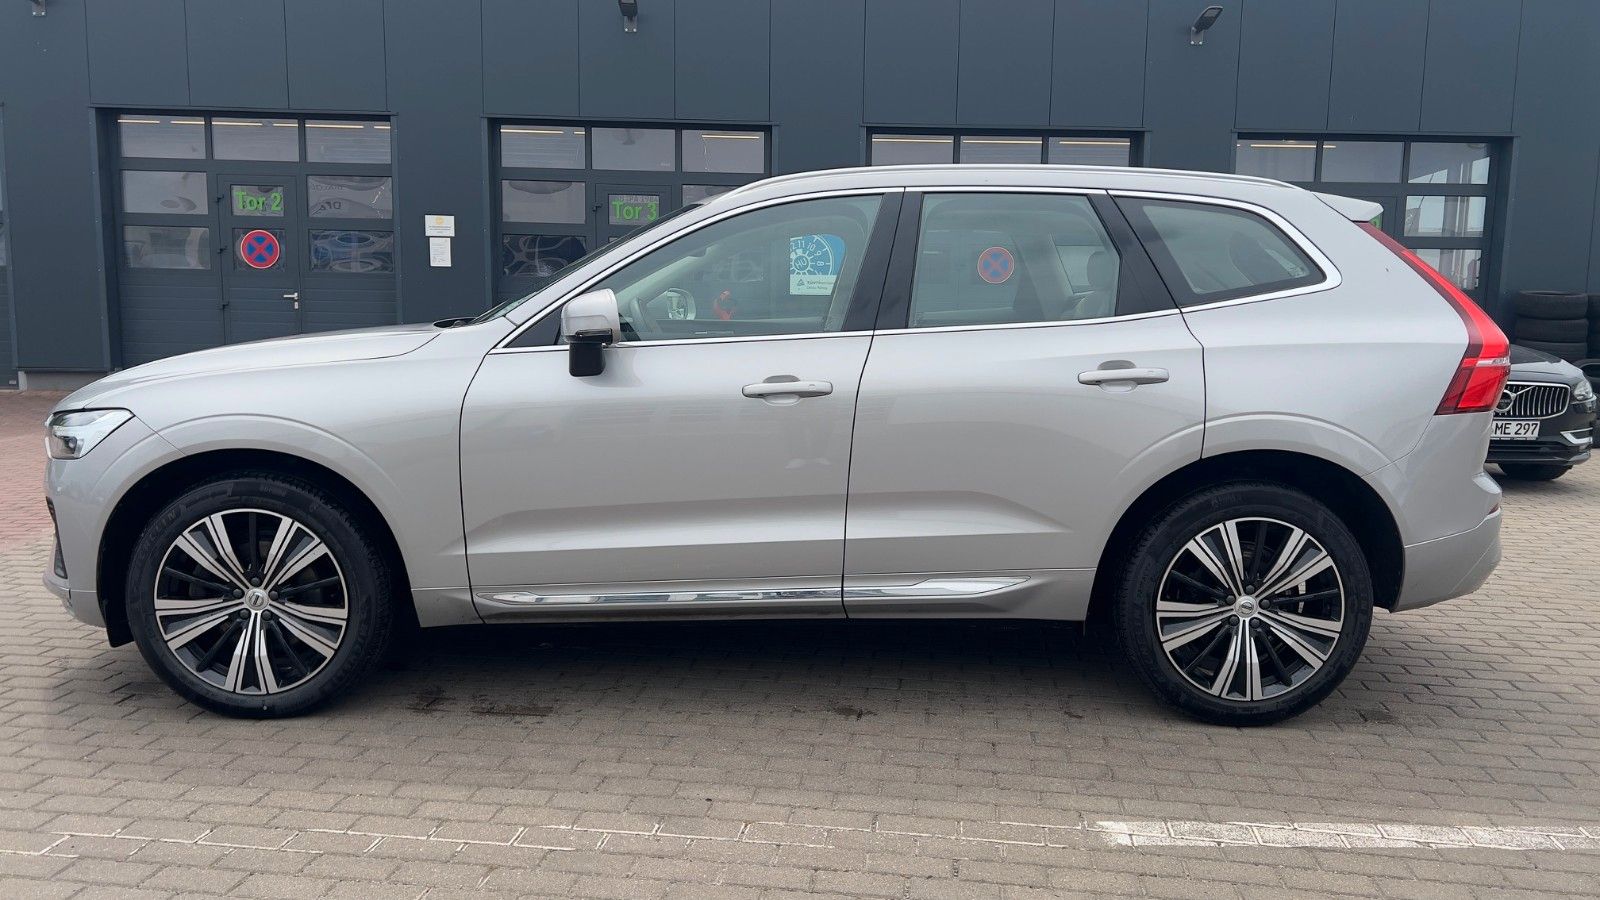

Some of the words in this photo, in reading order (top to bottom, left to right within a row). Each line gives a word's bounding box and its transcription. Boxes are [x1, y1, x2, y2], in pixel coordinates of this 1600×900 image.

[235, 191, 266, 212] Tor
[271, 192, 283, 212] 2
[611, 201, 643, 220] Tor
[647, 202, 657, 220] 3
[798, 240, 805, 248] 11
[807, 243, 816, 252] 10
[795, 257, 807, 269] HU
[1495, 423, 1511, 435] ME
[1515, 423, 1539, 436] 297
